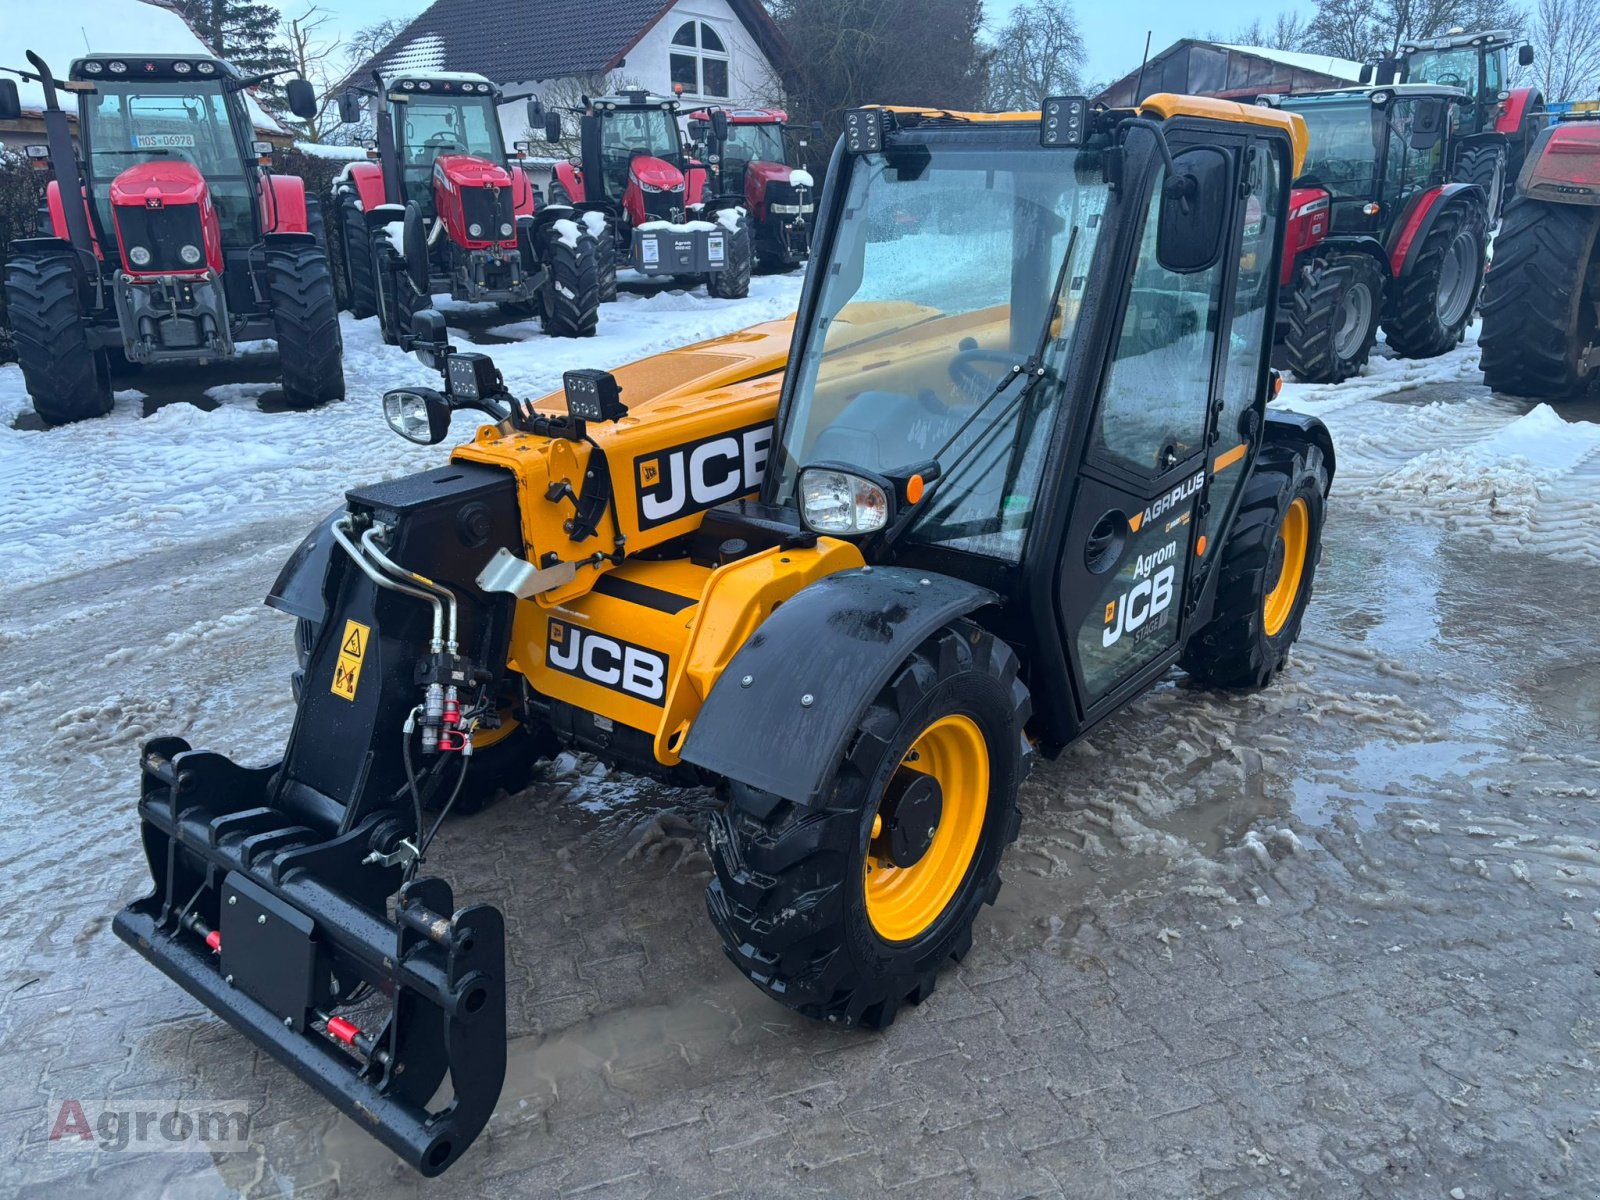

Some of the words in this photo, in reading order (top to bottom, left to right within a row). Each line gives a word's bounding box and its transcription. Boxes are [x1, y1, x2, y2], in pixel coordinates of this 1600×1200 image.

[138, 137, 157, 146] MOS
[1133, 541, 1176, 580] Agrom
[1103, 566, 1175, 648] JCB
[1135, 616, 1159, 643] STAGE
[549, 628, 665, 700] JCB
